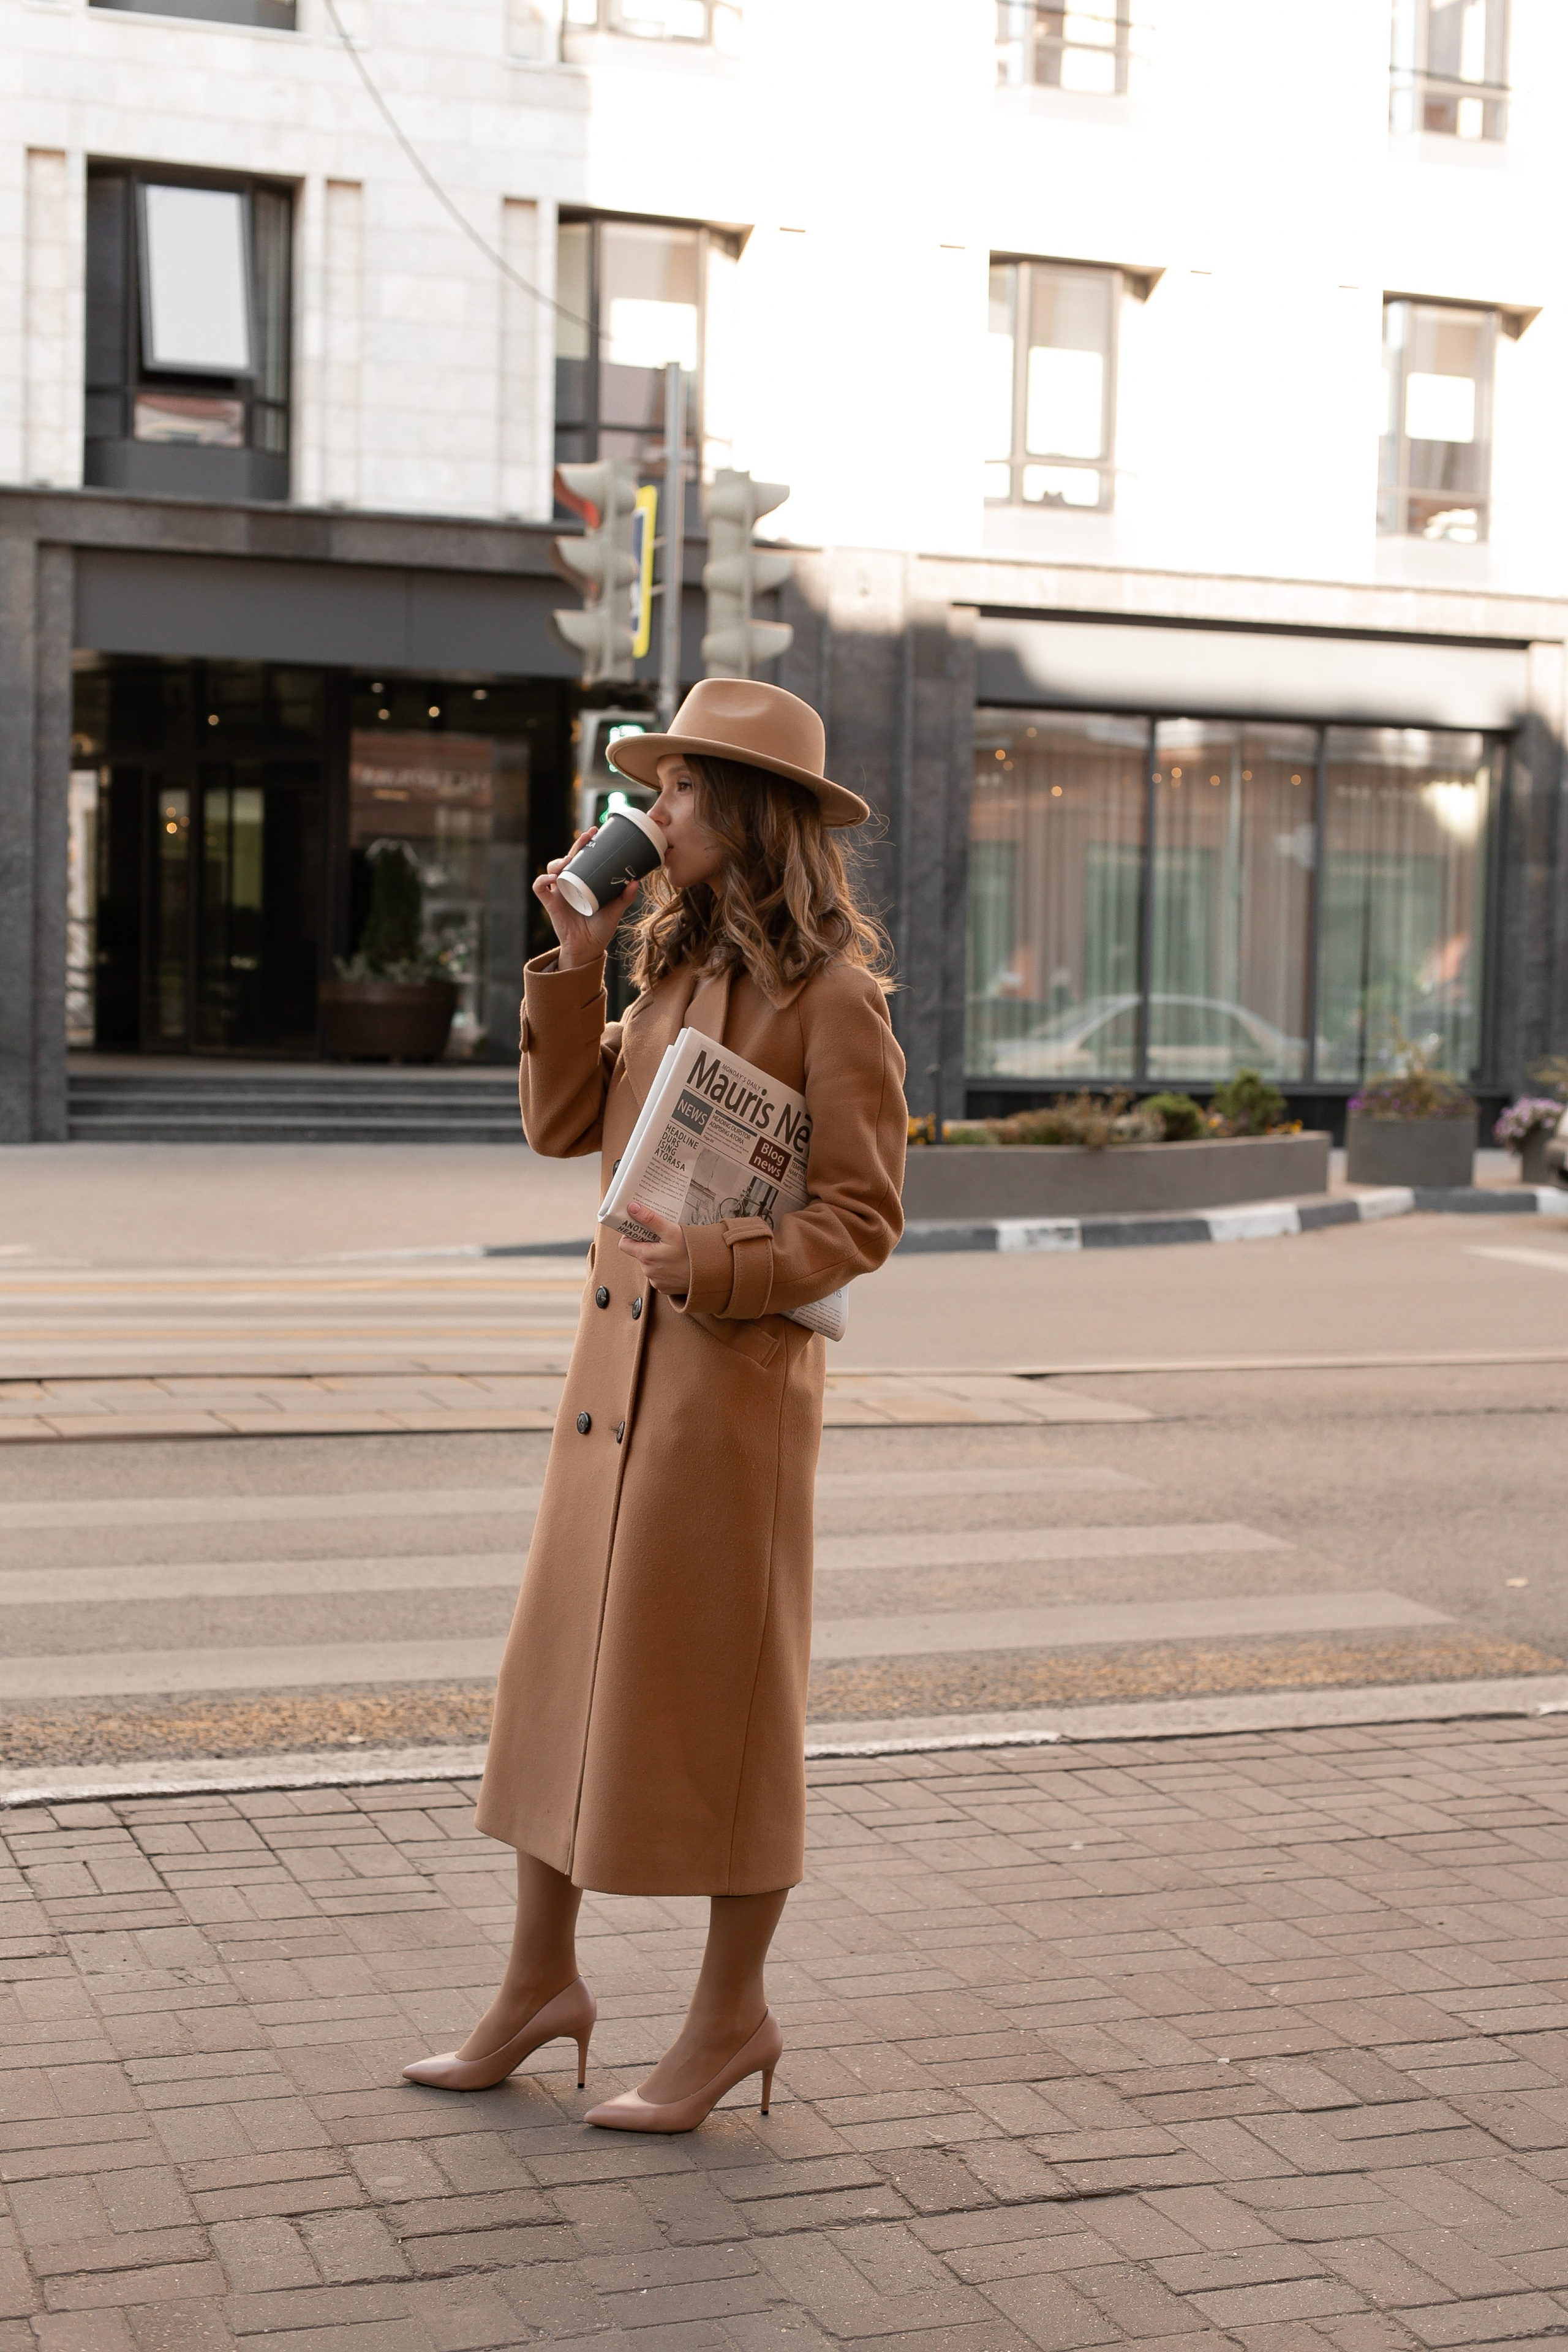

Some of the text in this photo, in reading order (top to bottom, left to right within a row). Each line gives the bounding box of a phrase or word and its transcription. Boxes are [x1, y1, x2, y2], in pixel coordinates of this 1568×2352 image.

[747, 1079, 761, 1091] DAILY
[677, 1099, 707, 1125] NEWS
[686, 1050, 775, 1129] Mauris
[774, 1103, 810, 1157] Ne
[665, 1123, 699, 1150] HEADLINE
[712, 1115, 731, 1129] HEADING
[731, 1126, 751, 1140] DURSTOR
[658, 1139, 677, 1156] ISING
[662, 1131, 680, 1148] DURS
[729, 1133, 744, 1145] ATORA
[654, 1148, 685, 1171] ATORASA
[761, 1143, 785, 1166] Blog
[753, 1156, 781, 1177] news
[622, 1220, 657, 1240] ANOTHER
